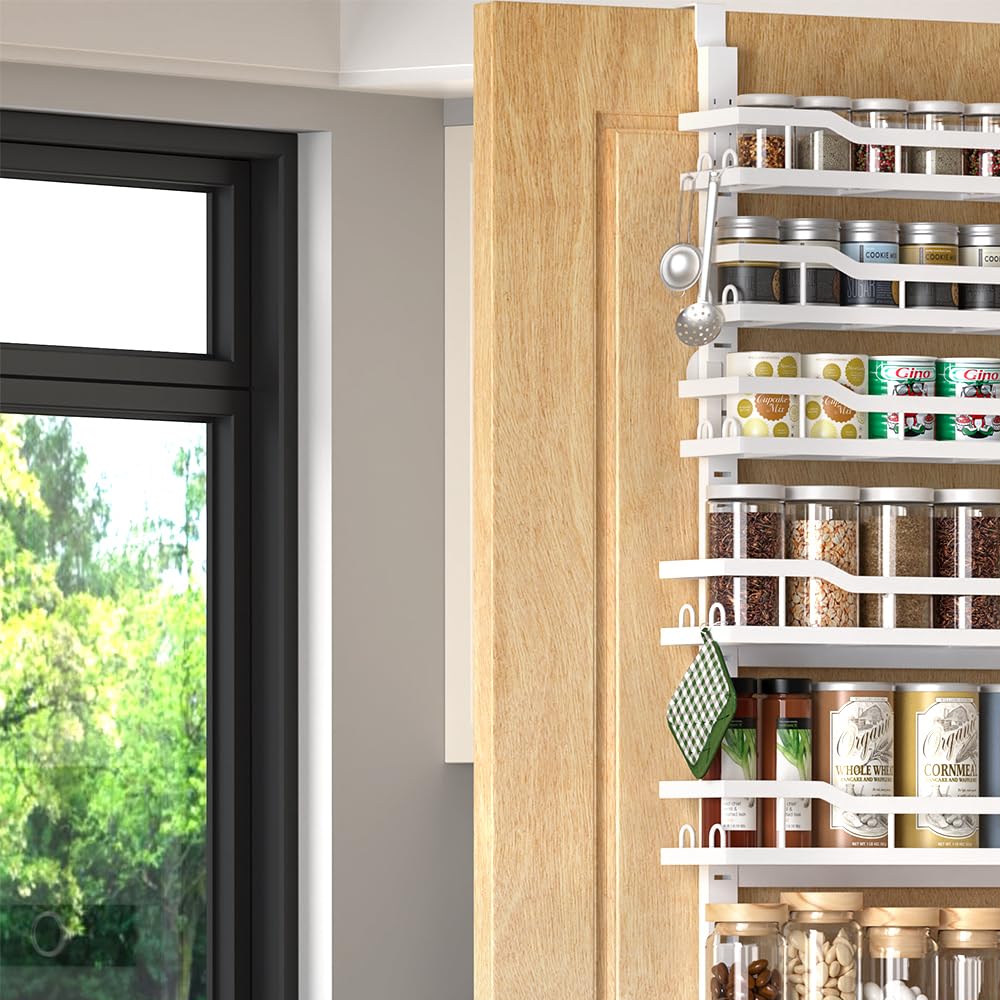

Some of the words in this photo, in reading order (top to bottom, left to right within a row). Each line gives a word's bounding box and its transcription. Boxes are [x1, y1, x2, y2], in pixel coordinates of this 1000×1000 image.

[866, 251, 889, 260] COOKIE
[925, 252, 949, 261] COOKIE
[896, 368, 931, 378] Gino
[964, 369, 999, 381] Gino
[836, 765, 872, 776] WHOLE
